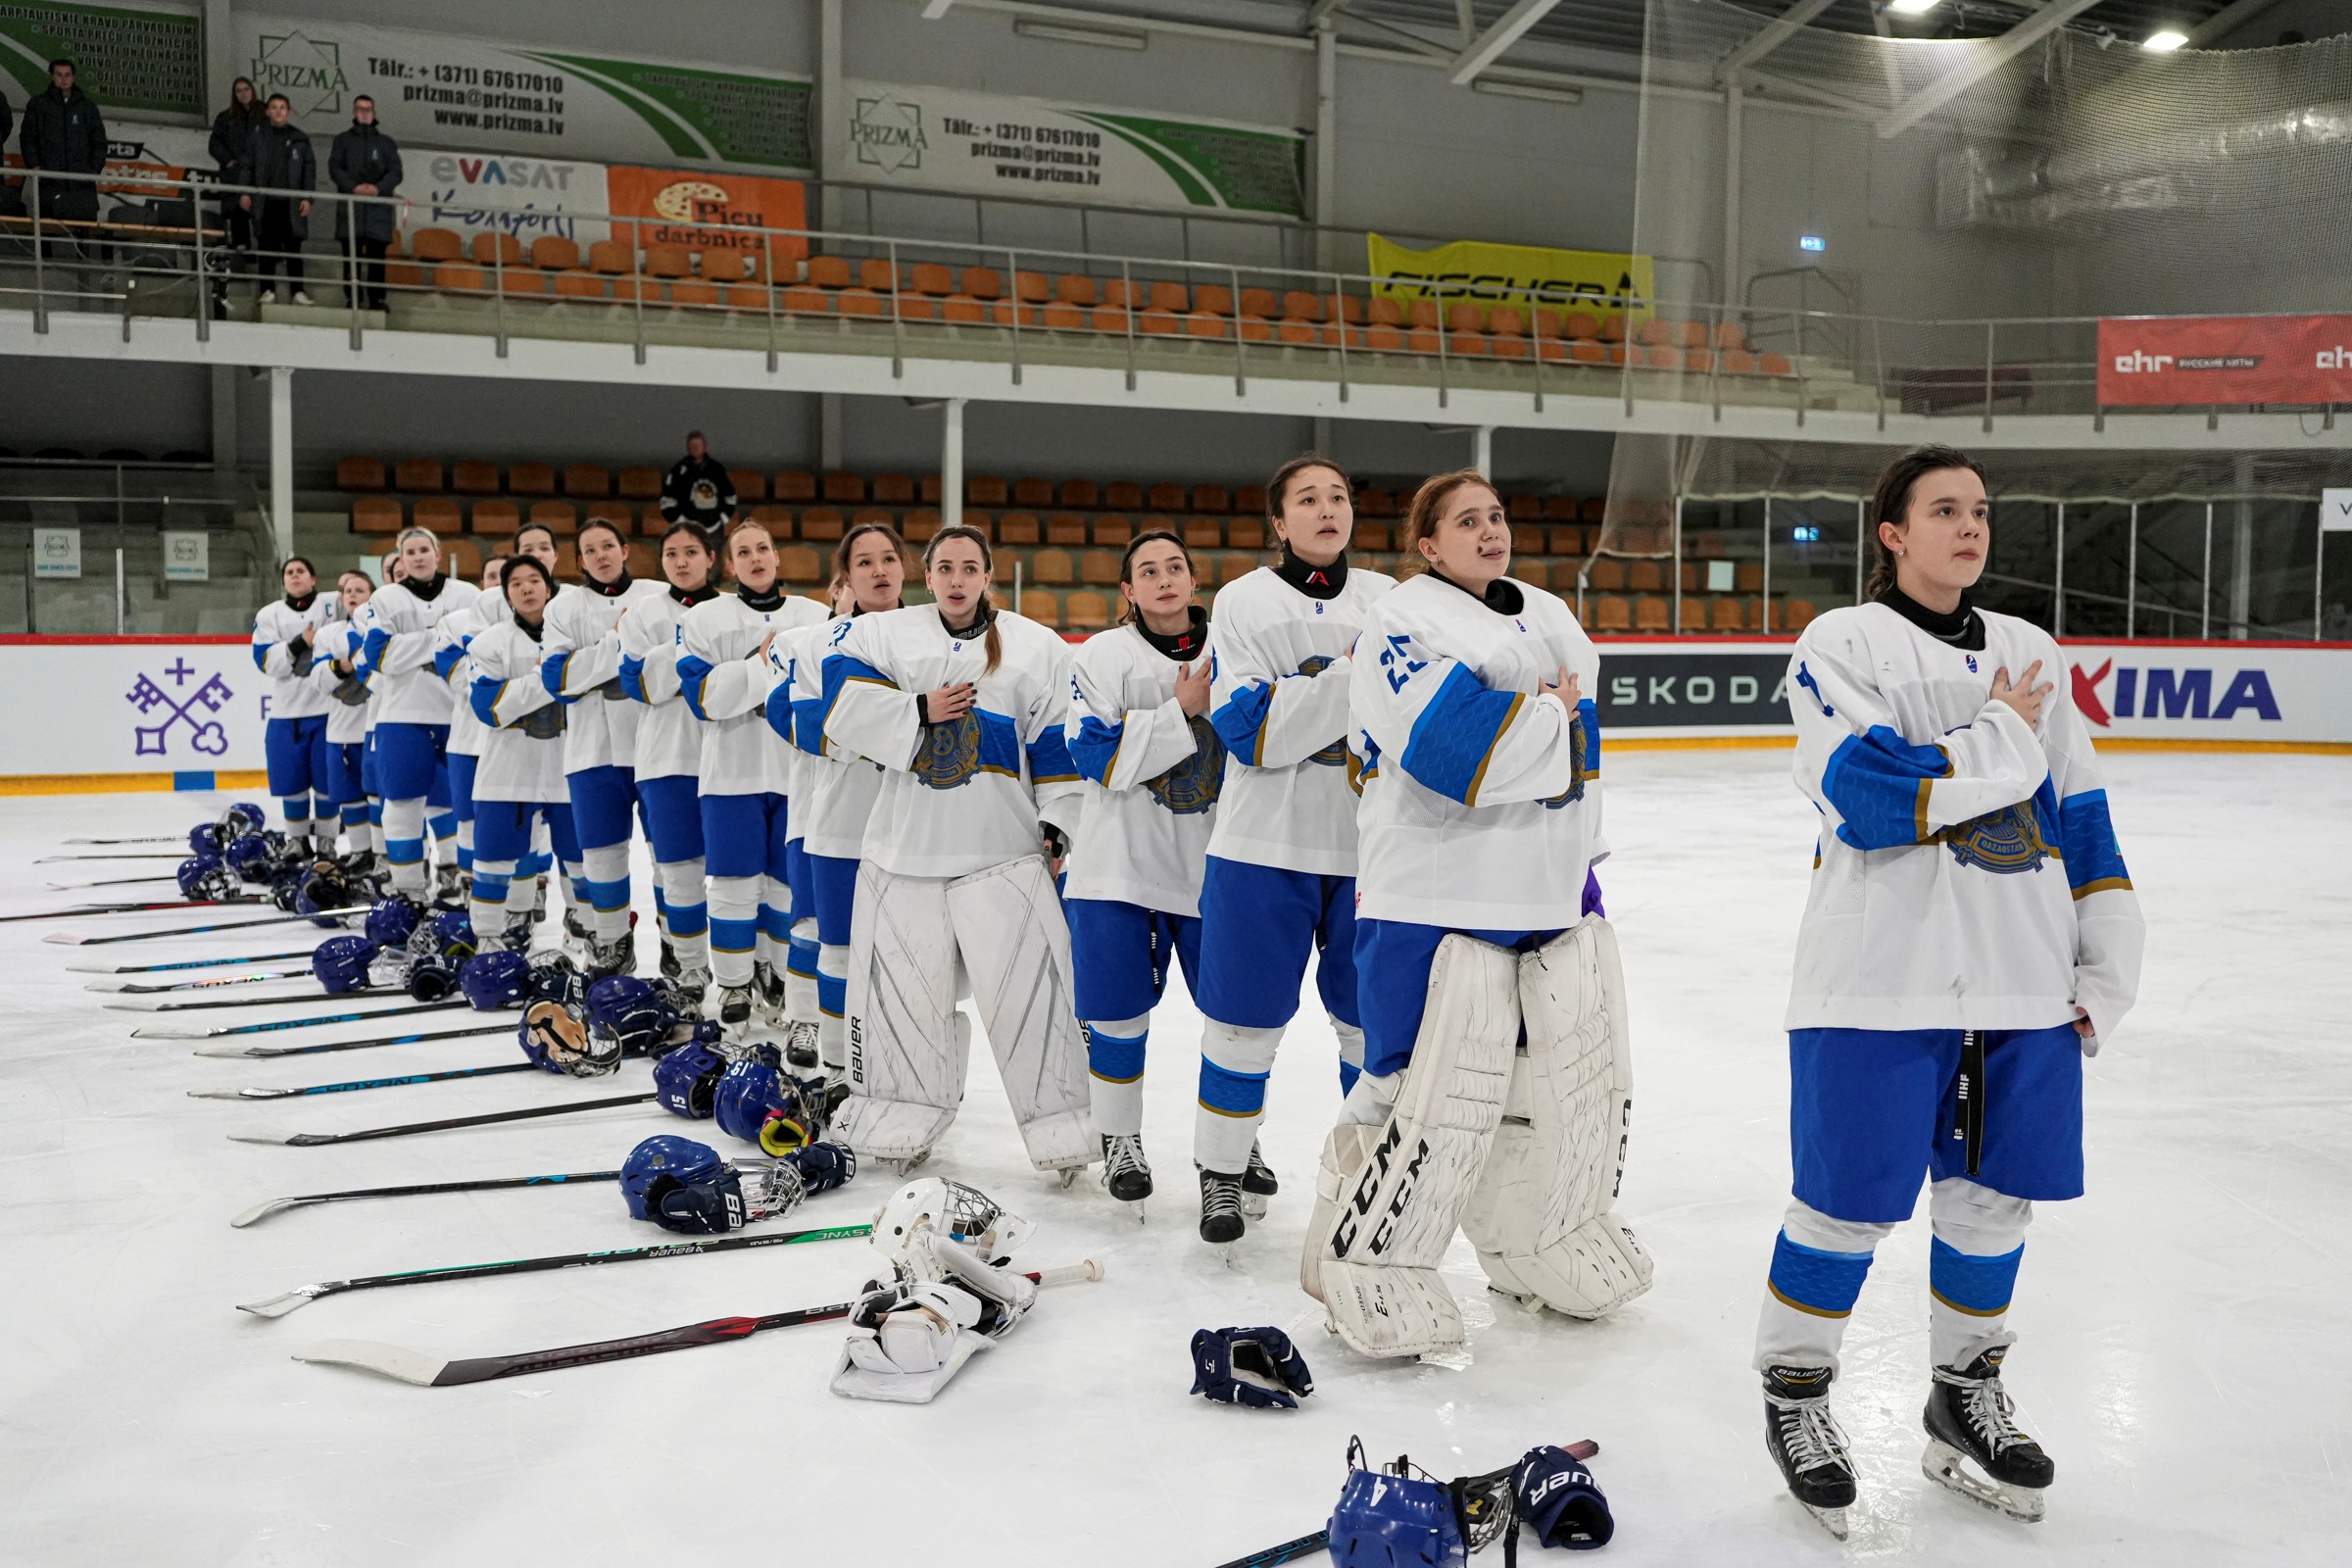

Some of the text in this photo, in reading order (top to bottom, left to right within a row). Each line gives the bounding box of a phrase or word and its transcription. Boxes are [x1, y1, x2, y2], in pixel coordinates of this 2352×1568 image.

[251, 57, 350, 92] PRIZMA
[483, 70, 564, 94] 67617010
[403, 84, 564, 115] prizma@prizma.lv
[434, 109, 564, 135] www.prizma.lv
[849, 118, 929, 150] PRIZMA
[970, 142, 1101, 168] prizma@prizma.lv
[996, 164, 1101, 185] www.prizma.lv
[1383, 271, 1605, 308] FISCHER
[2115, 350, 2174, 373] ehr
[1981, 839, 2025, 854] QAZAQSTAN
[1958, 1074, 1970, 1100] IIHF
[671, 1094, 687, 1109] 15
[1330, 1118, 1403, 1259] CCM
[1367, 1138, 1430, 1256] CCM
